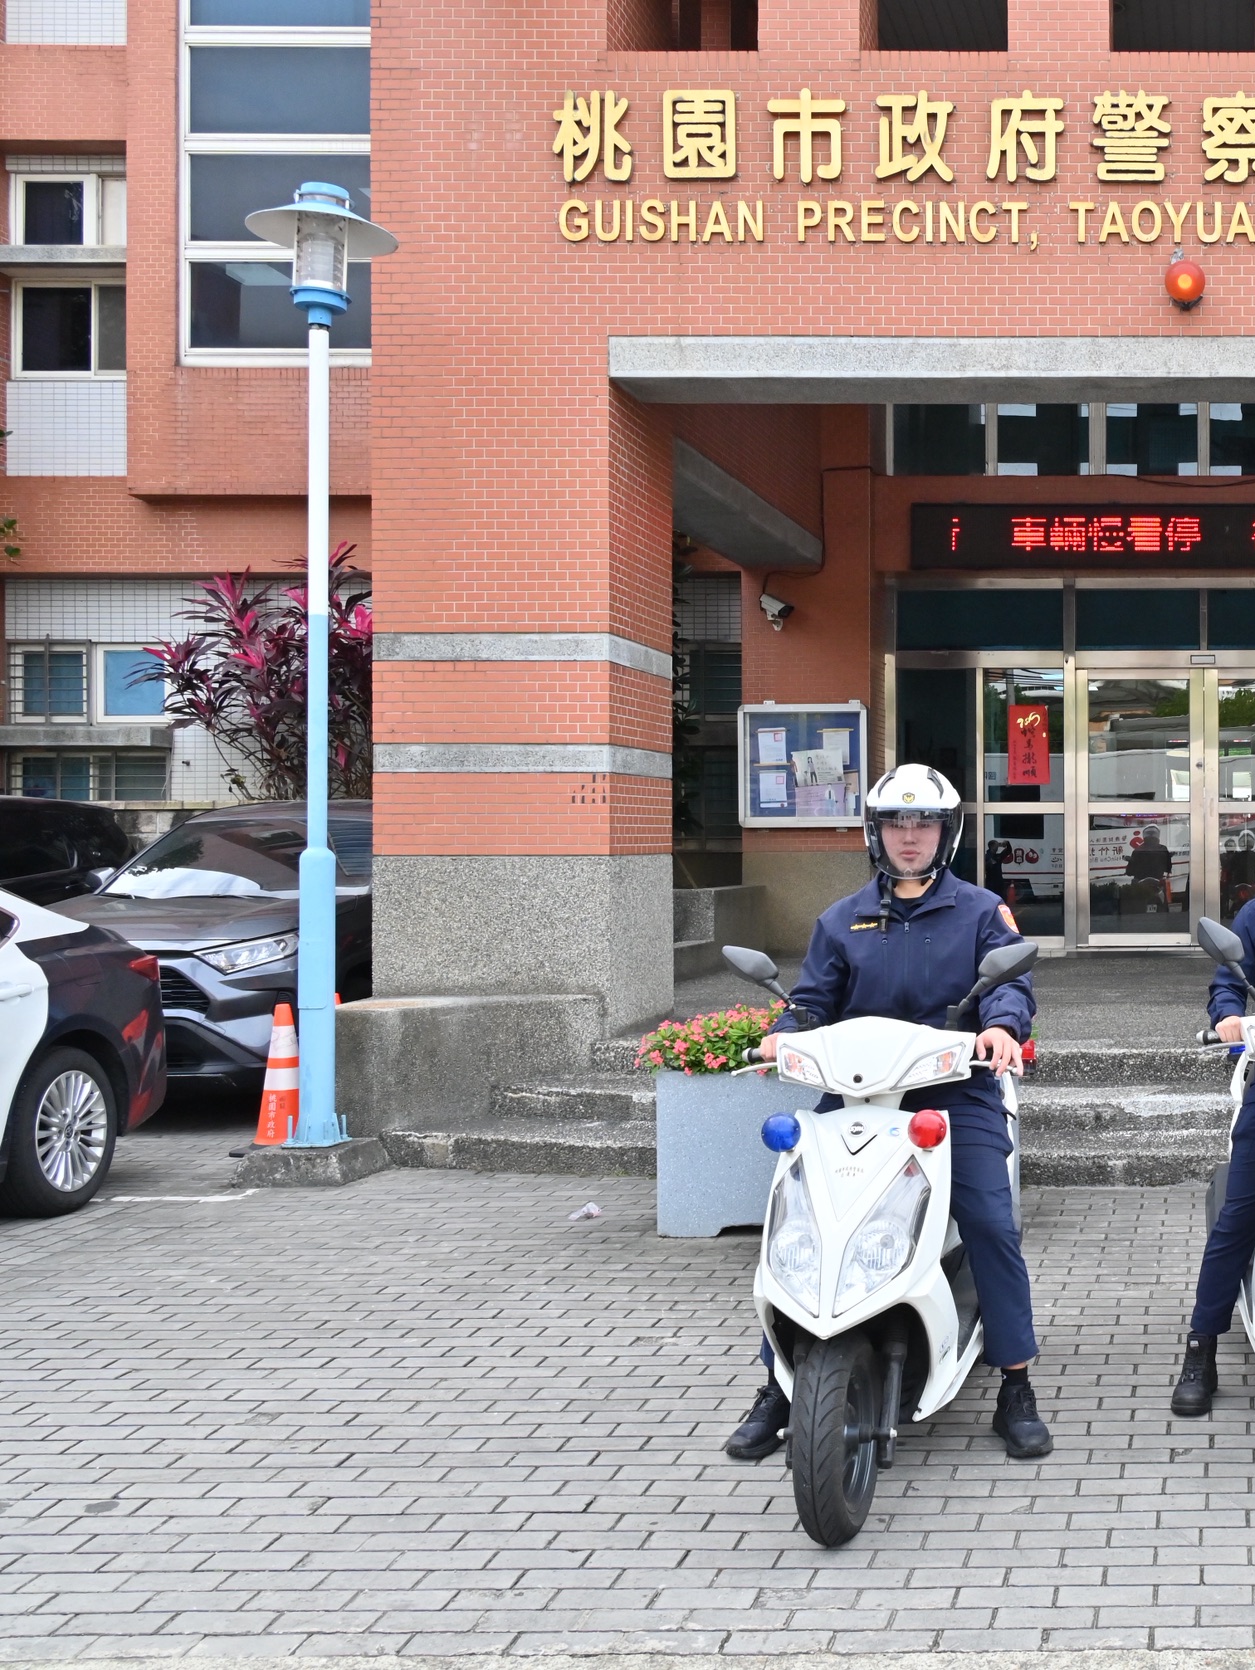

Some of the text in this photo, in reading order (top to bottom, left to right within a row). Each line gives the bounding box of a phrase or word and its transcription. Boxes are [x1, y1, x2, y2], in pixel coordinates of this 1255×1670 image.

[558, 199, 765, 243] GUISHAN
[798, 199, 1039, 251] PRECINCT,
[266, 1093, 277, 1138] 桃園市政府
